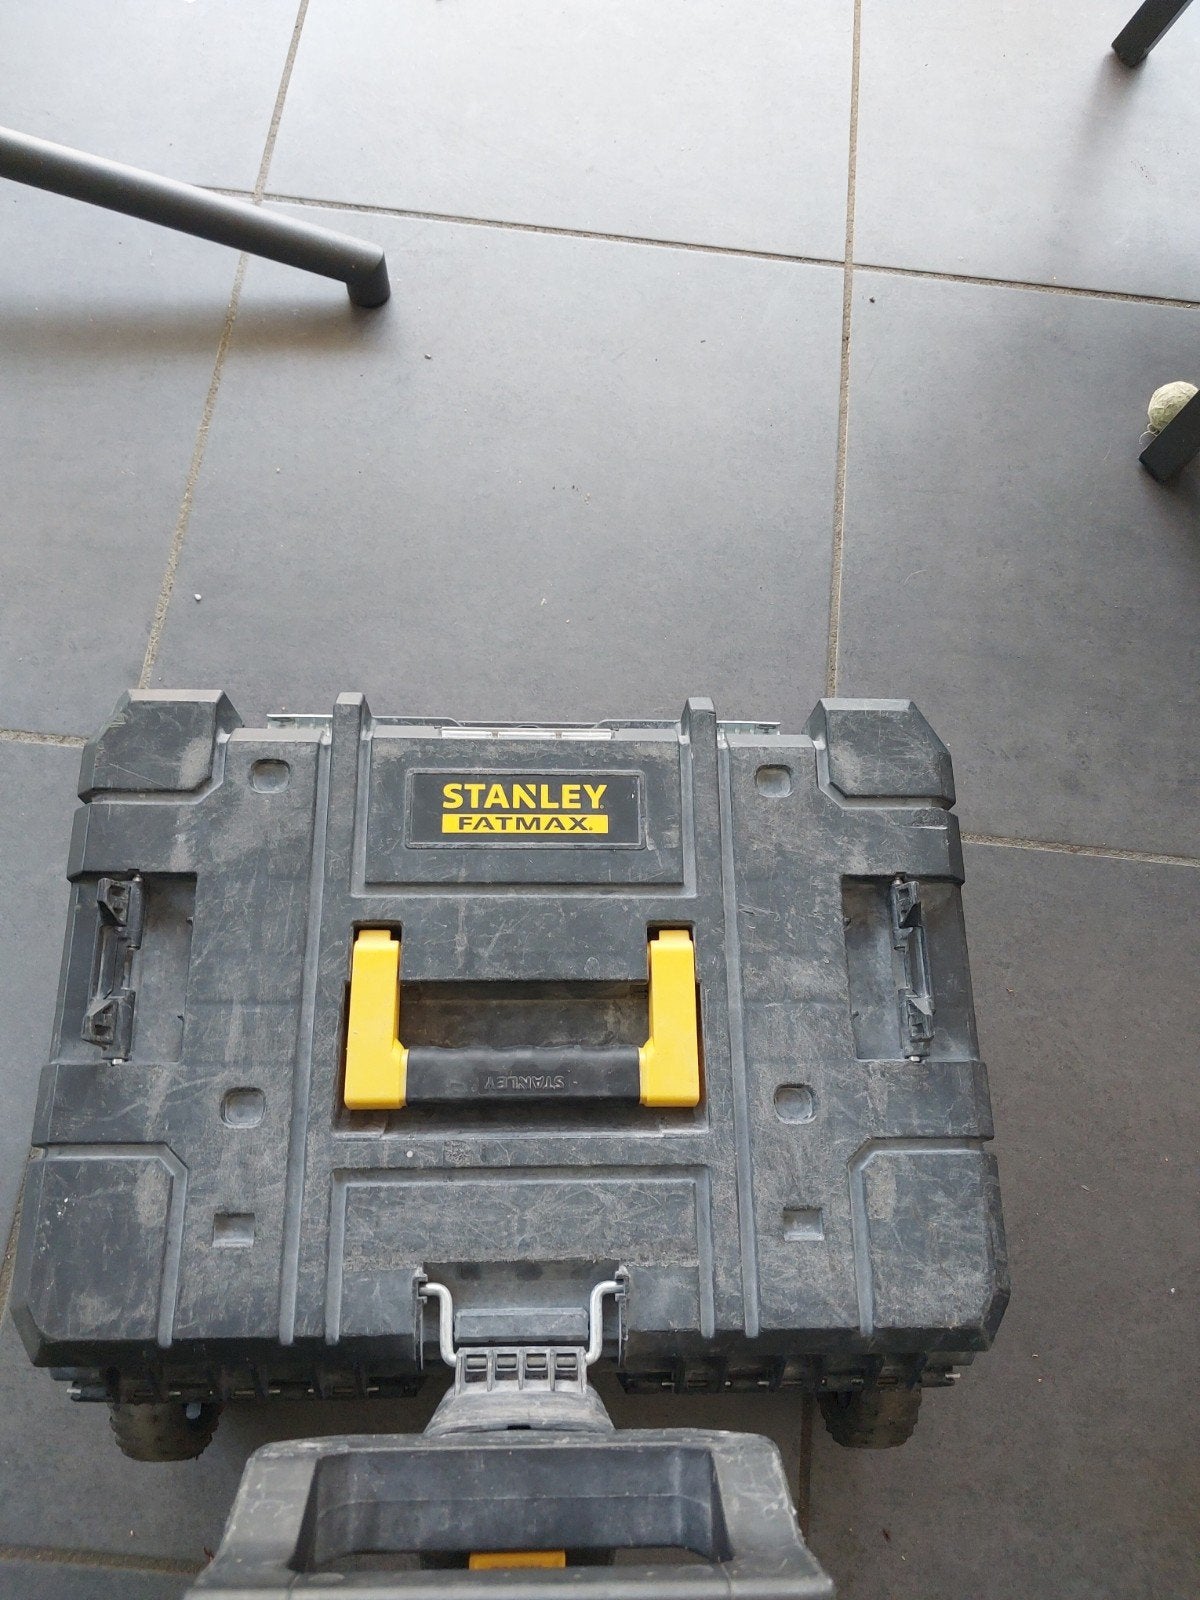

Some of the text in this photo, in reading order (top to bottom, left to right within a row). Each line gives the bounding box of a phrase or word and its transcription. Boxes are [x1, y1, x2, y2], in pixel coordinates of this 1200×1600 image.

[442, 783, 608, 809] STANLEY
[458, 816, 593, 831] FATMAX
[484, 1075, 565, 1090] STANLEY
